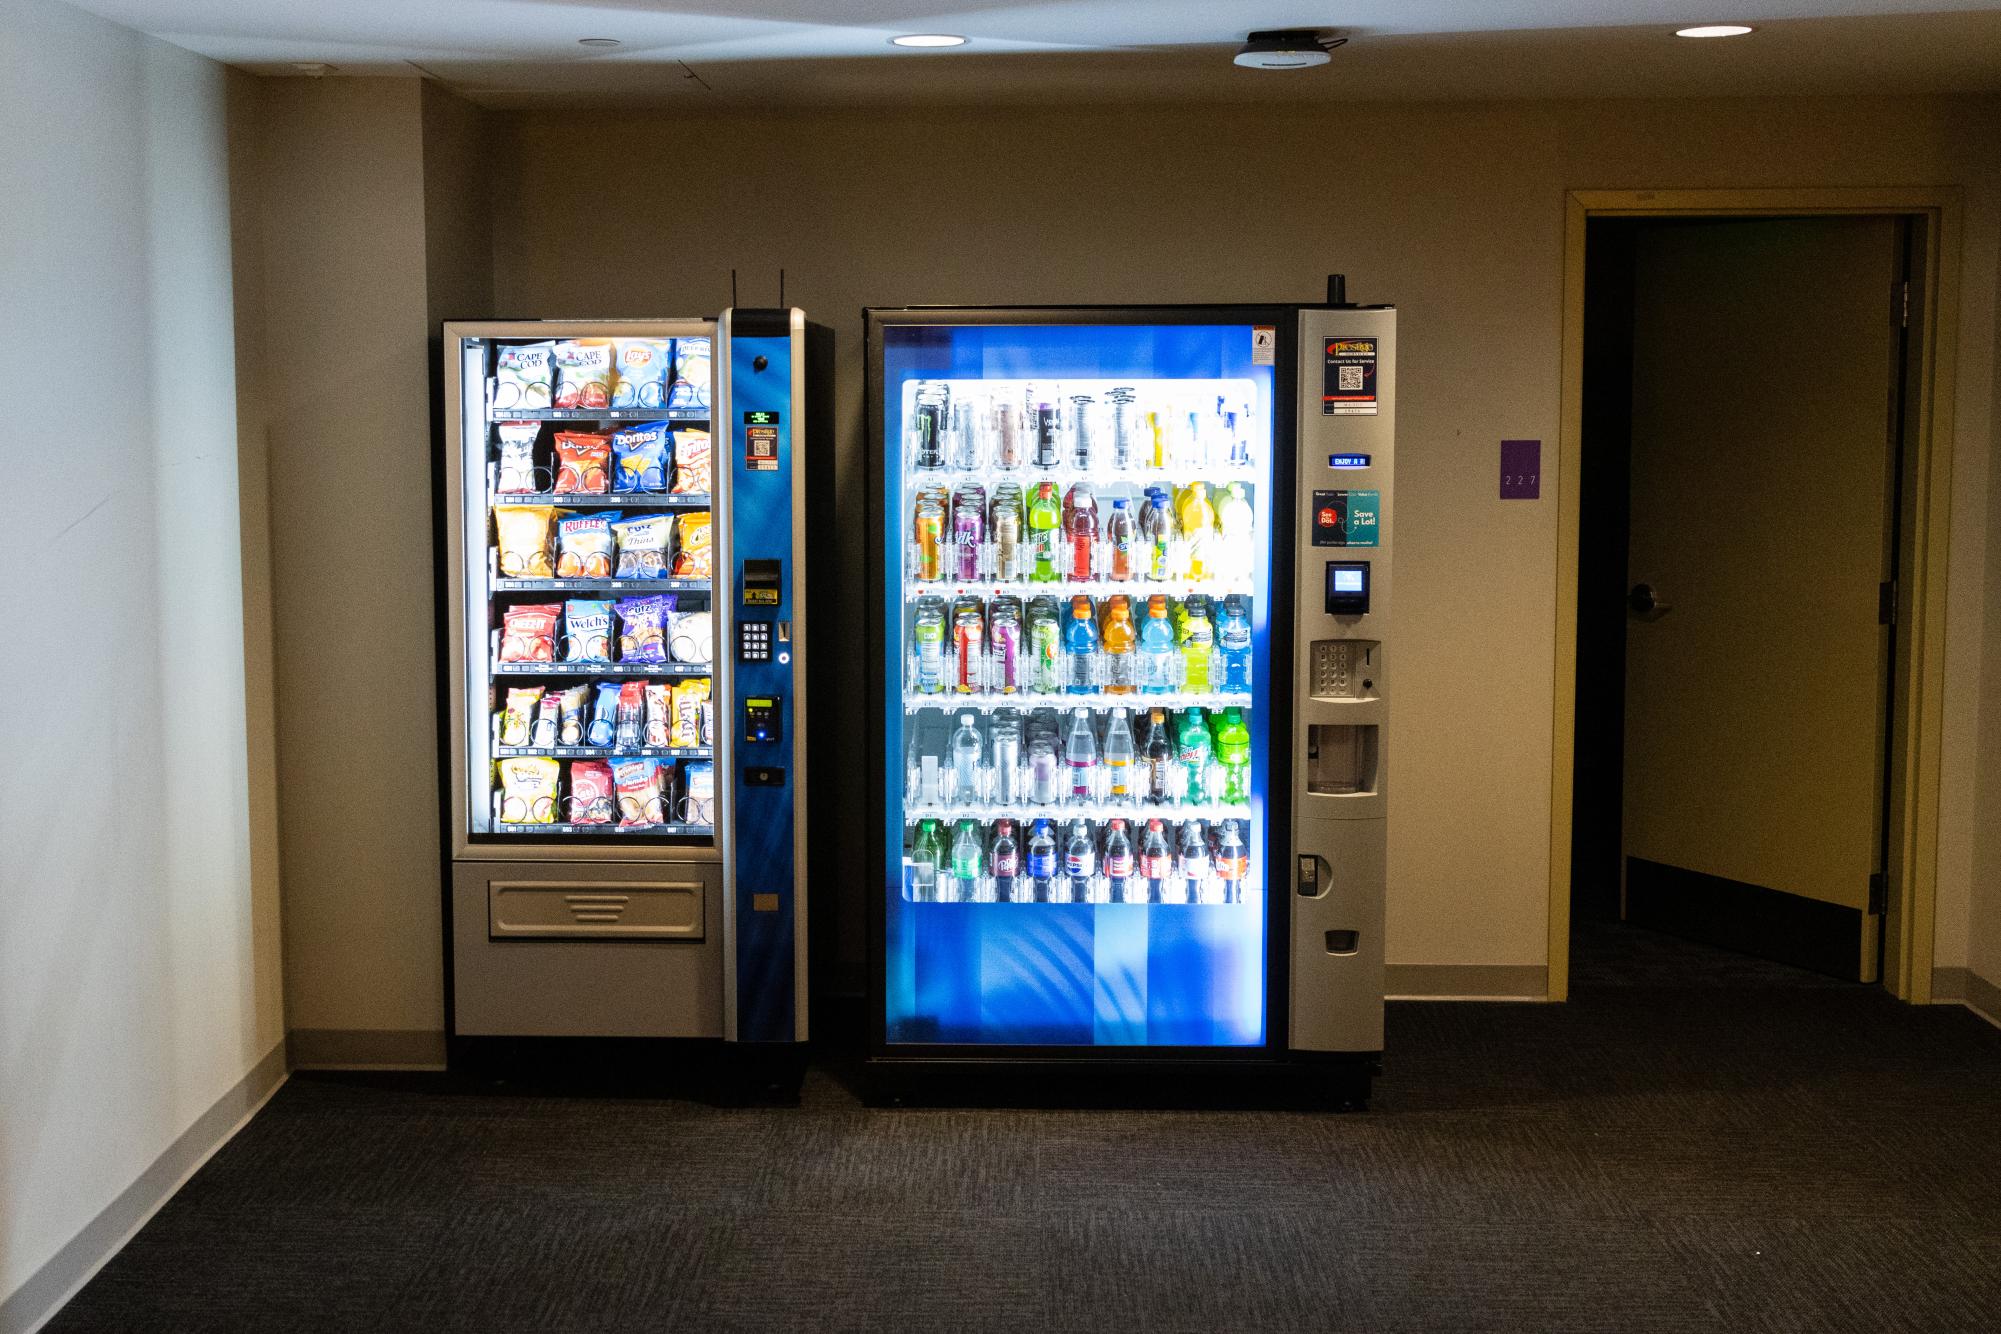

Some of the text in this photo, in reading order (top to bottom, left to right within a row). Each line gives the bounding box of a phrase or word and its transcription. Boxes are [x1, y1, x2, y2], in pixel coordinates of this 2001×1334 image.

[516, 352, 543, 362] CAPE
[576, 350, 602, 361] CAPE
[520, 360, 542, 369] COD
[615, 431, 658, 445] Doritos
[570, 615, 608, 628] Welch's
